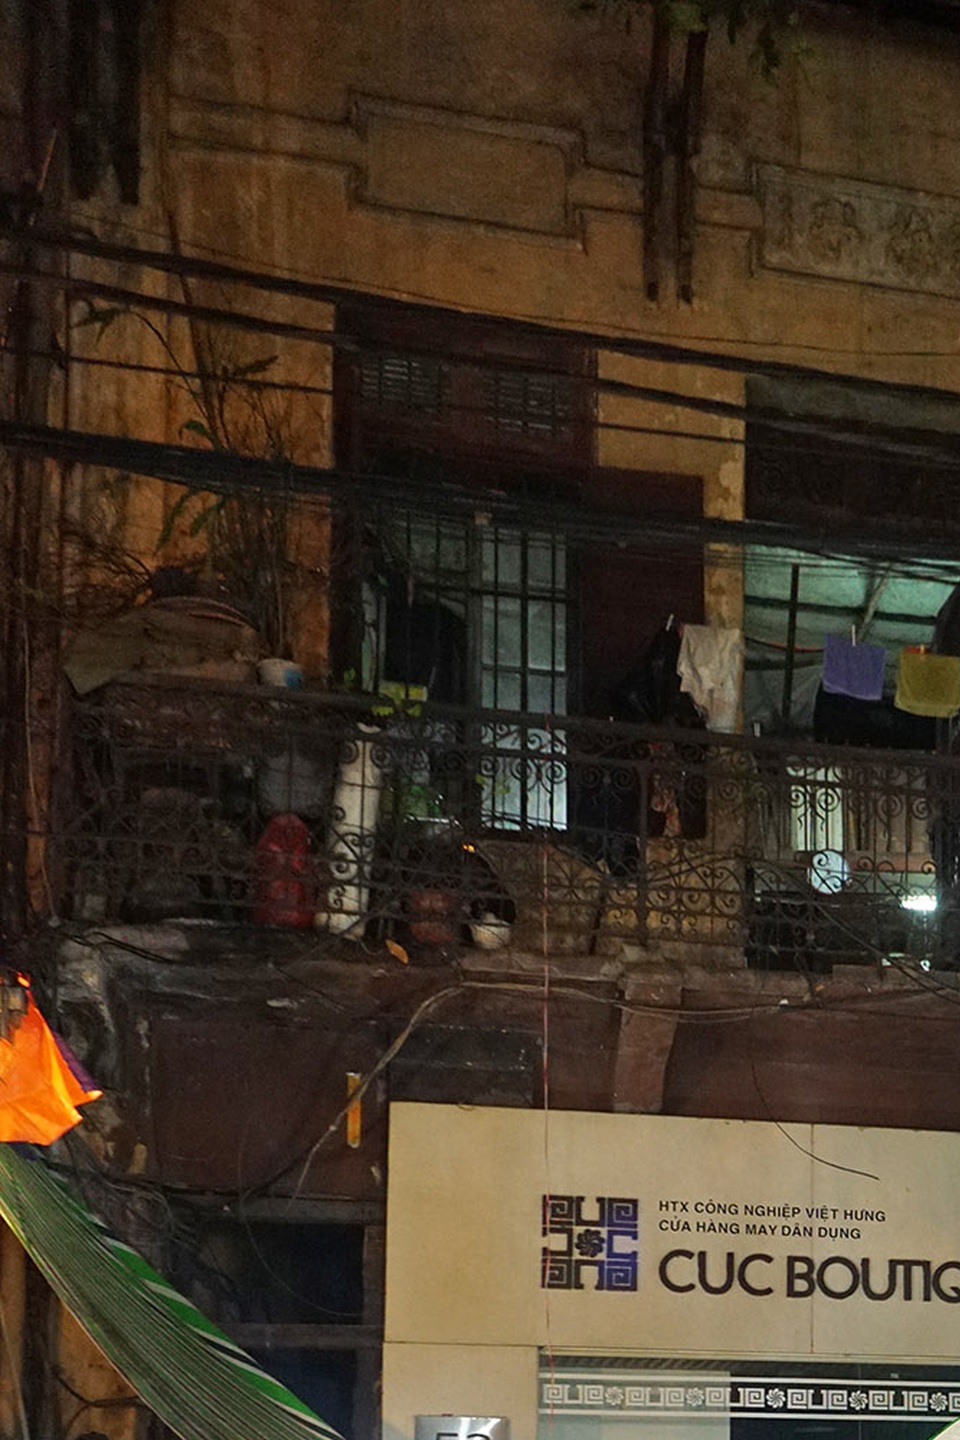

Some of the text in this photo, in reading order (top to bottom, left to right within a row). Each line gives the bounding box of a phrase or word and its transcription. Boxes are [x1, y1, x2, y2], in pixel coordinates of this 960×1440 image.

[659, 1199, 886, 1222] HTX CÔNG NGHIỆP VIỆT HƯNG
[658, 1215, 861, 1242] CỬA HÀNG MAY DÂN DỤNG
[658, 1248, 774, 1297] CUC
